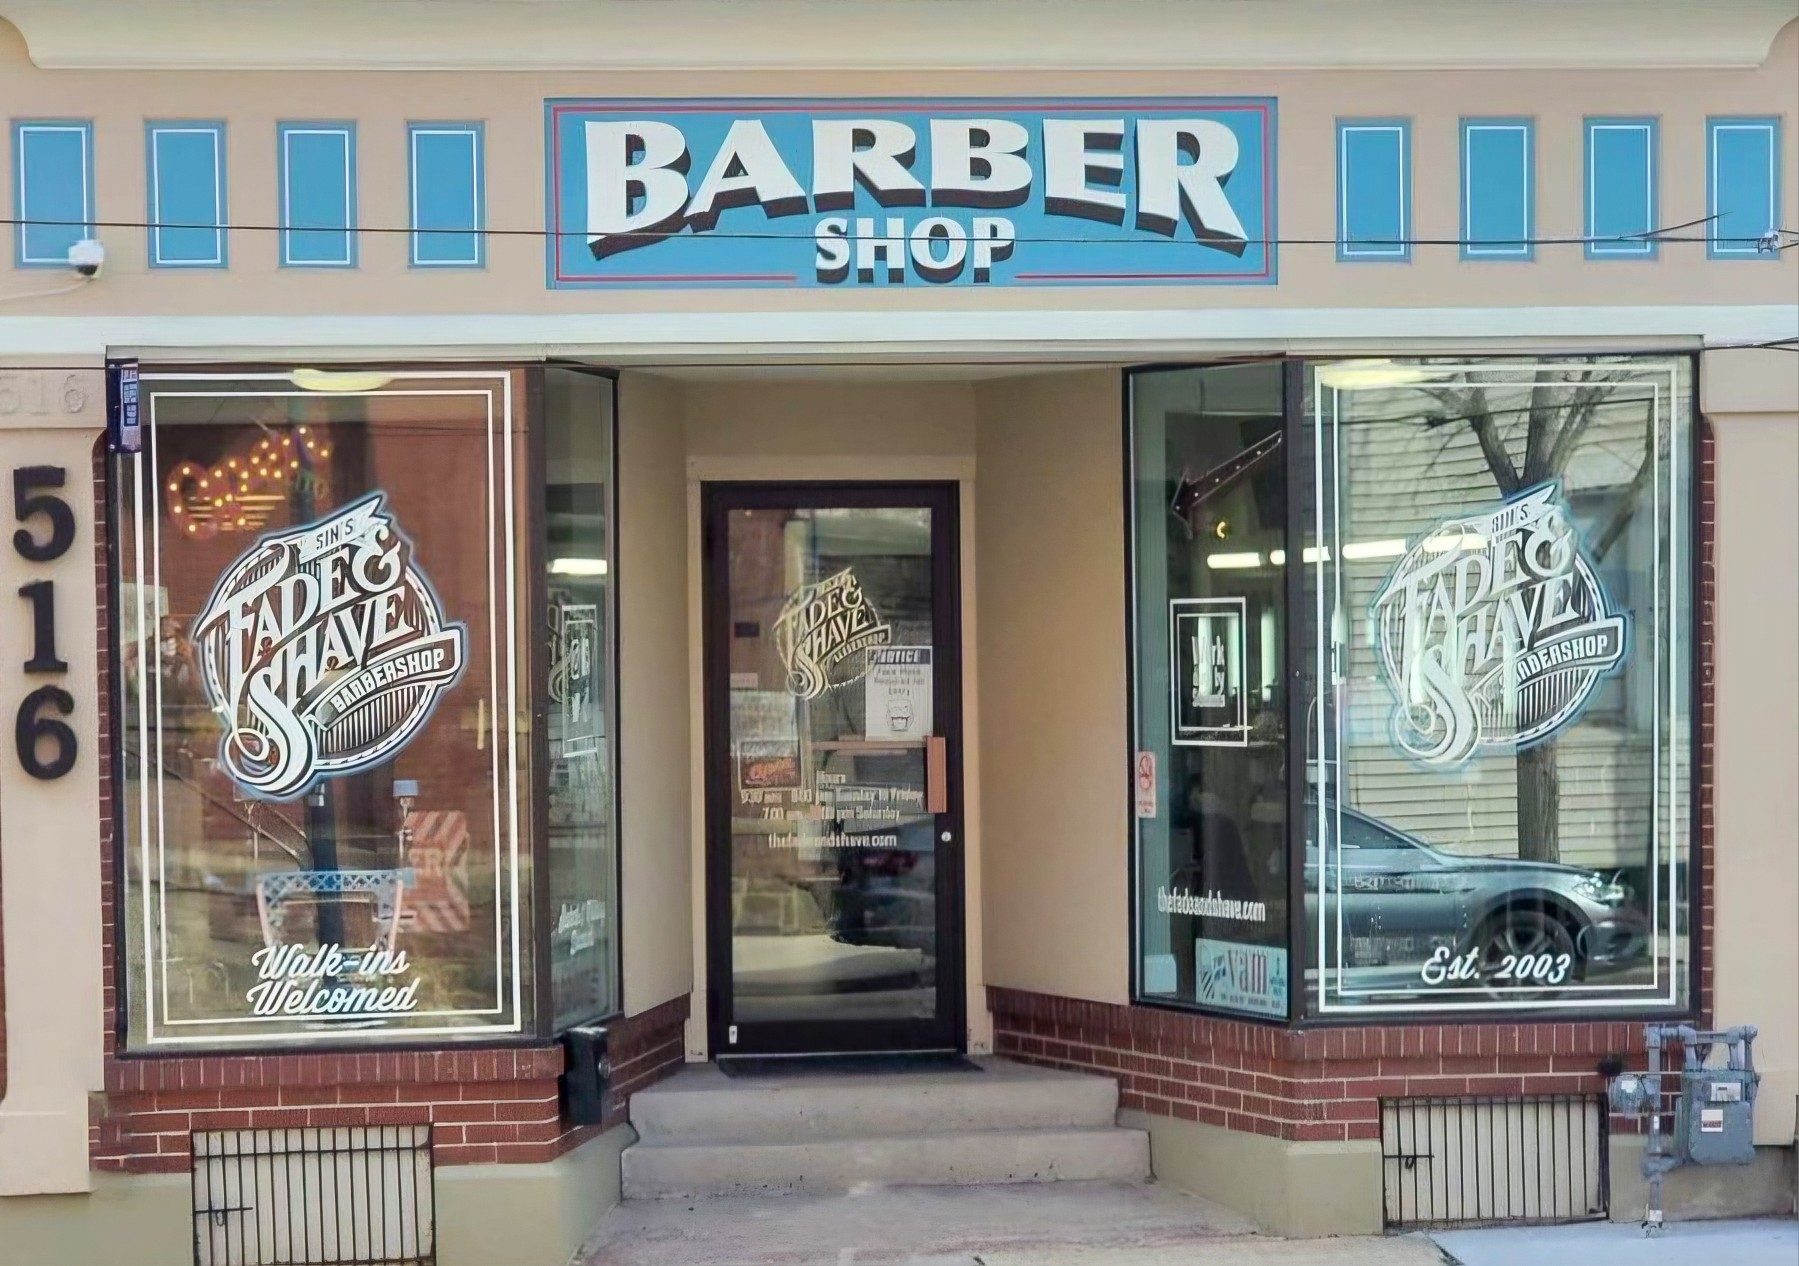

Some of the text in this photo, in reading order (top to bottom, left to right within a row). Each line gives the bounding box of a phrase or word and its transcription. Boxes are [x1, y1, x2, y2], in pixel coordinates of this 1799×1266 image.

[585, 118, 1249, 257] BARBER
[815, 216, 1015, 283] SHOP
[225, 586, 417, 791] SHAVE
[251, 943, 411, 980] Walk-ins
[1421, 946, 1571, 986] Est. 2003
[246, 976, 421, 1016] Welcomed
